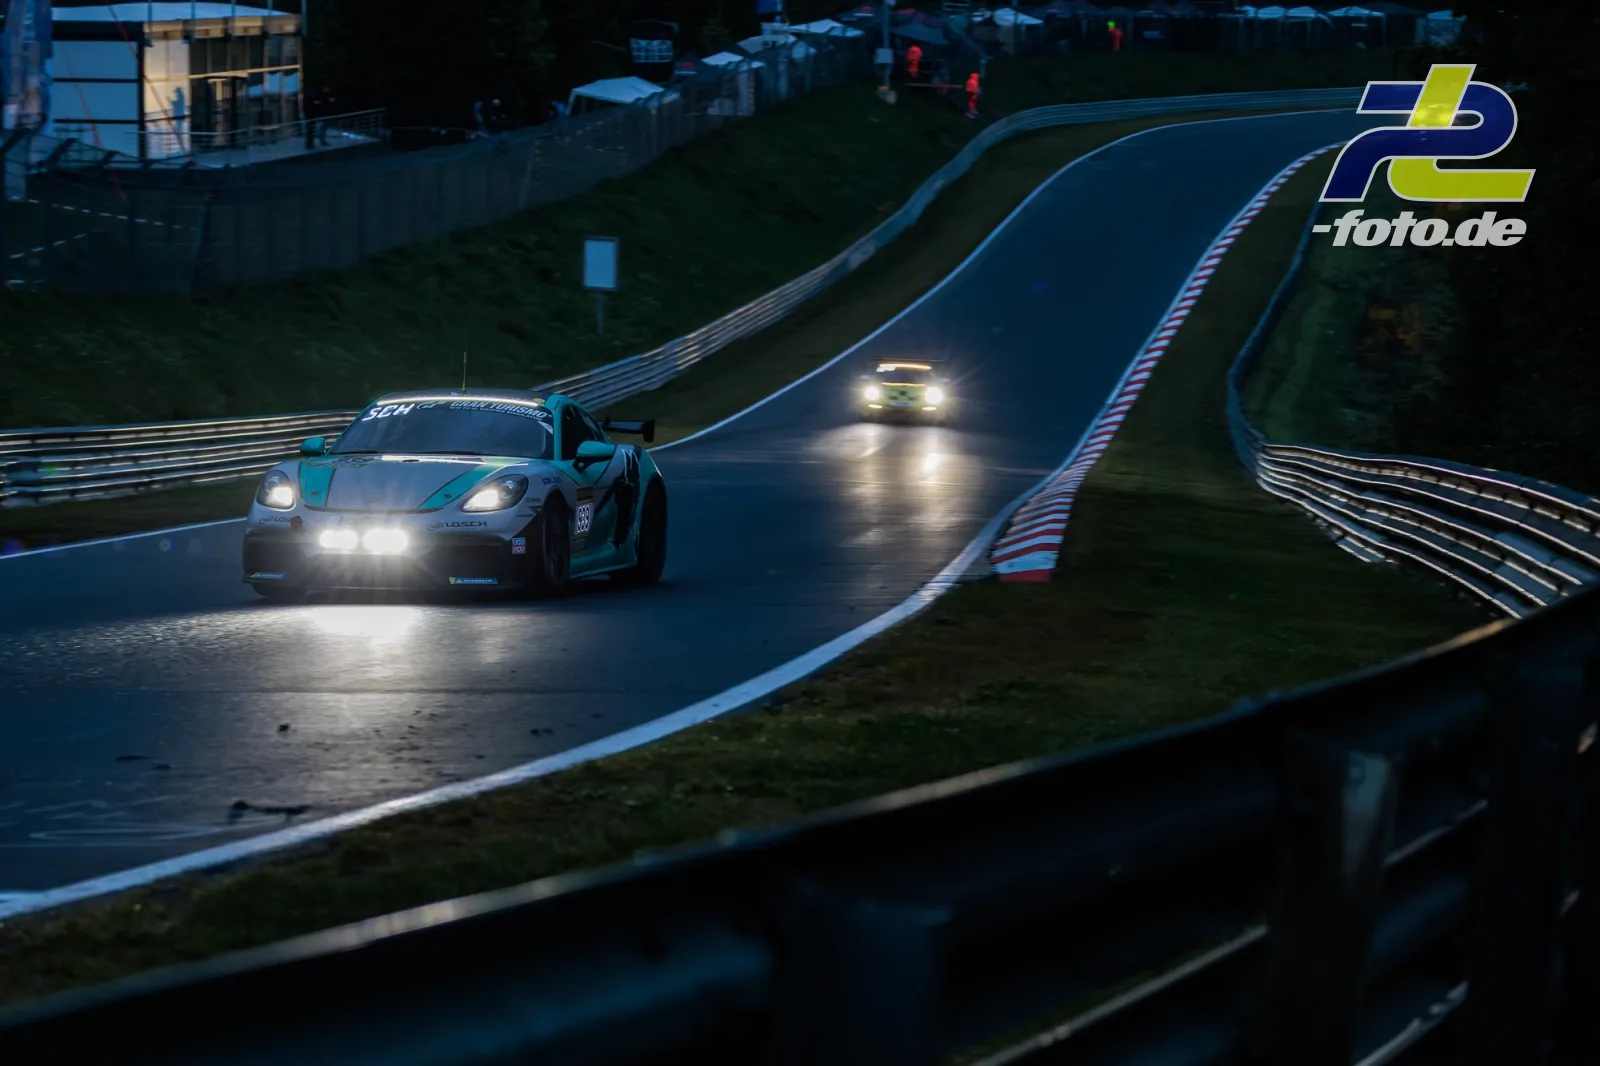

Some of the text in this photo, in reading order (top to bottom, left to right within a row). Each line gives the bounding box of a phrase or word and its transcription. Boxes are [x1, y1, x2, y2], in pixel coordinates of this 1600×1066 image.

[361, 403, 415, 421] SCH
[450, 400, 548, 418] GRAN TURISMO
